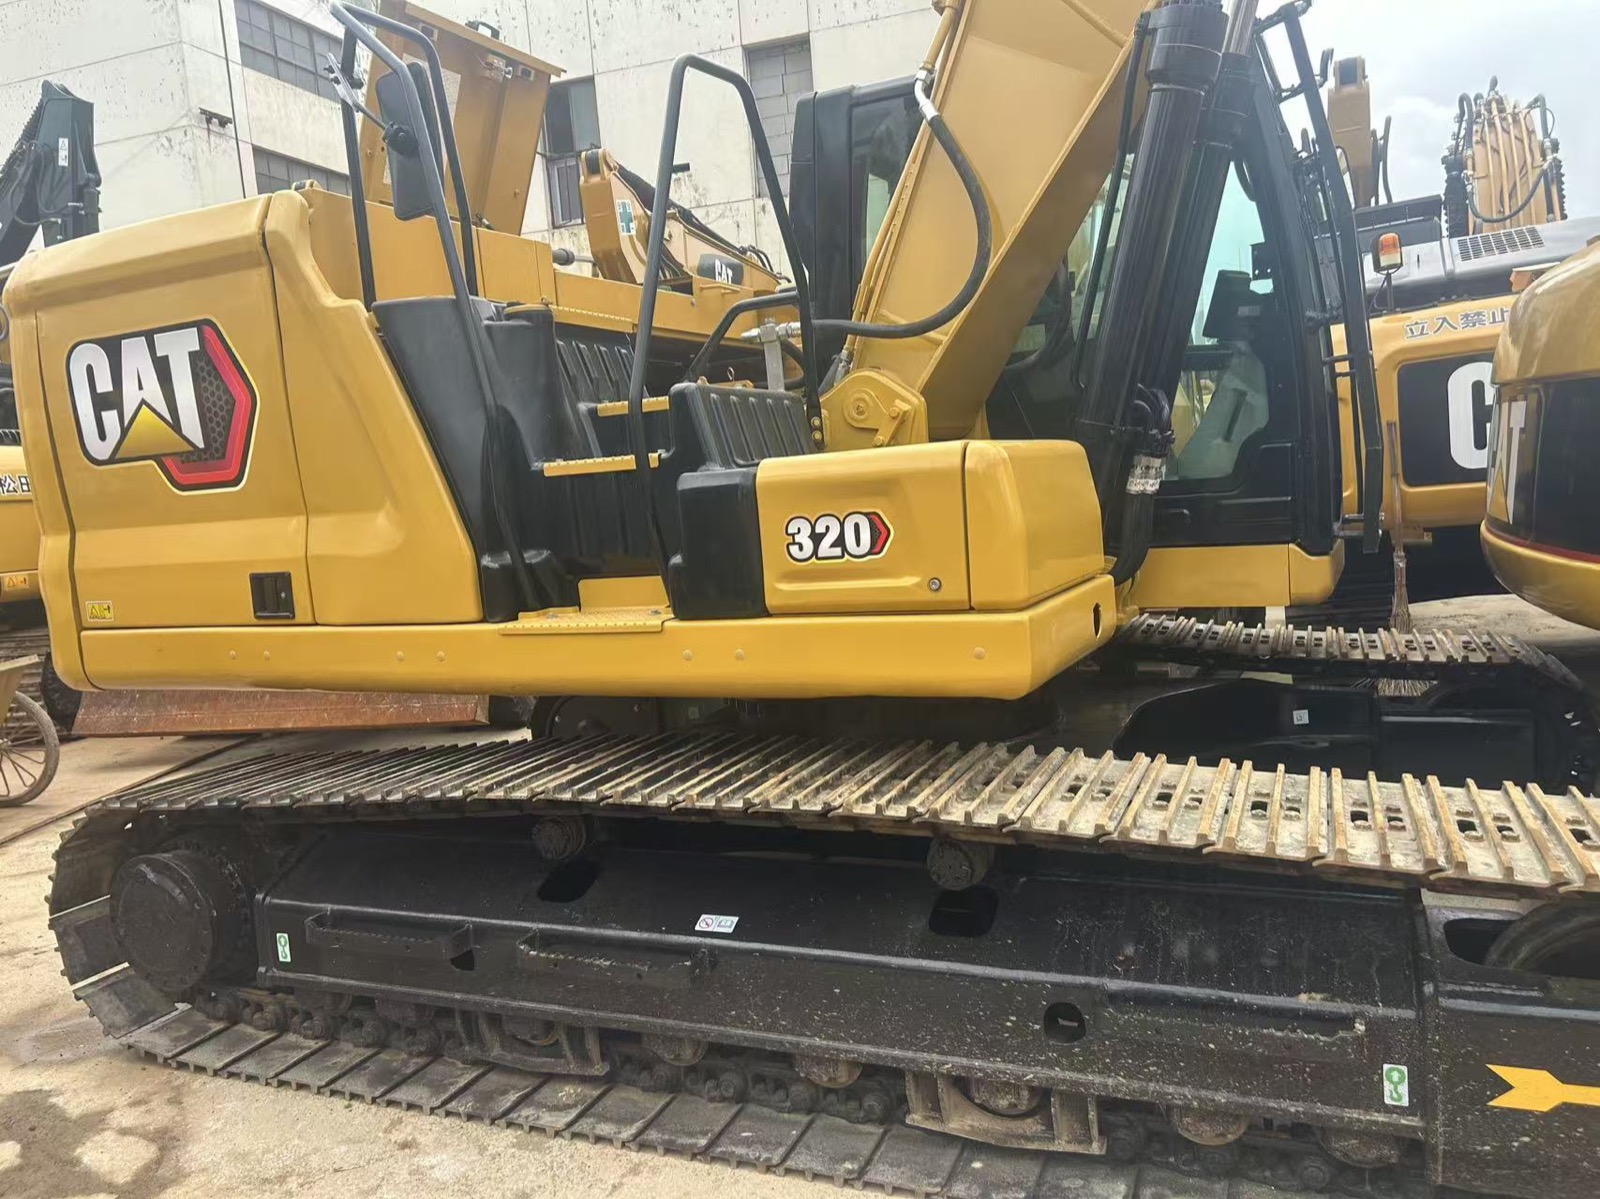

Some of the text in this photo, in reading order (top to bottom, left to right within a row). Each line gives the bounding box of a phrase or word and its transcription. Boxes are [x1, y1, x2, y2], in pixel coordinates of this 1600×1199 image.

[714, 258, 733, 285] CAT
[1404, 306, 1511, 340] 立入禁止
[69, 326, 205, 461] CAT
[786, 513, 872, 561] 320
